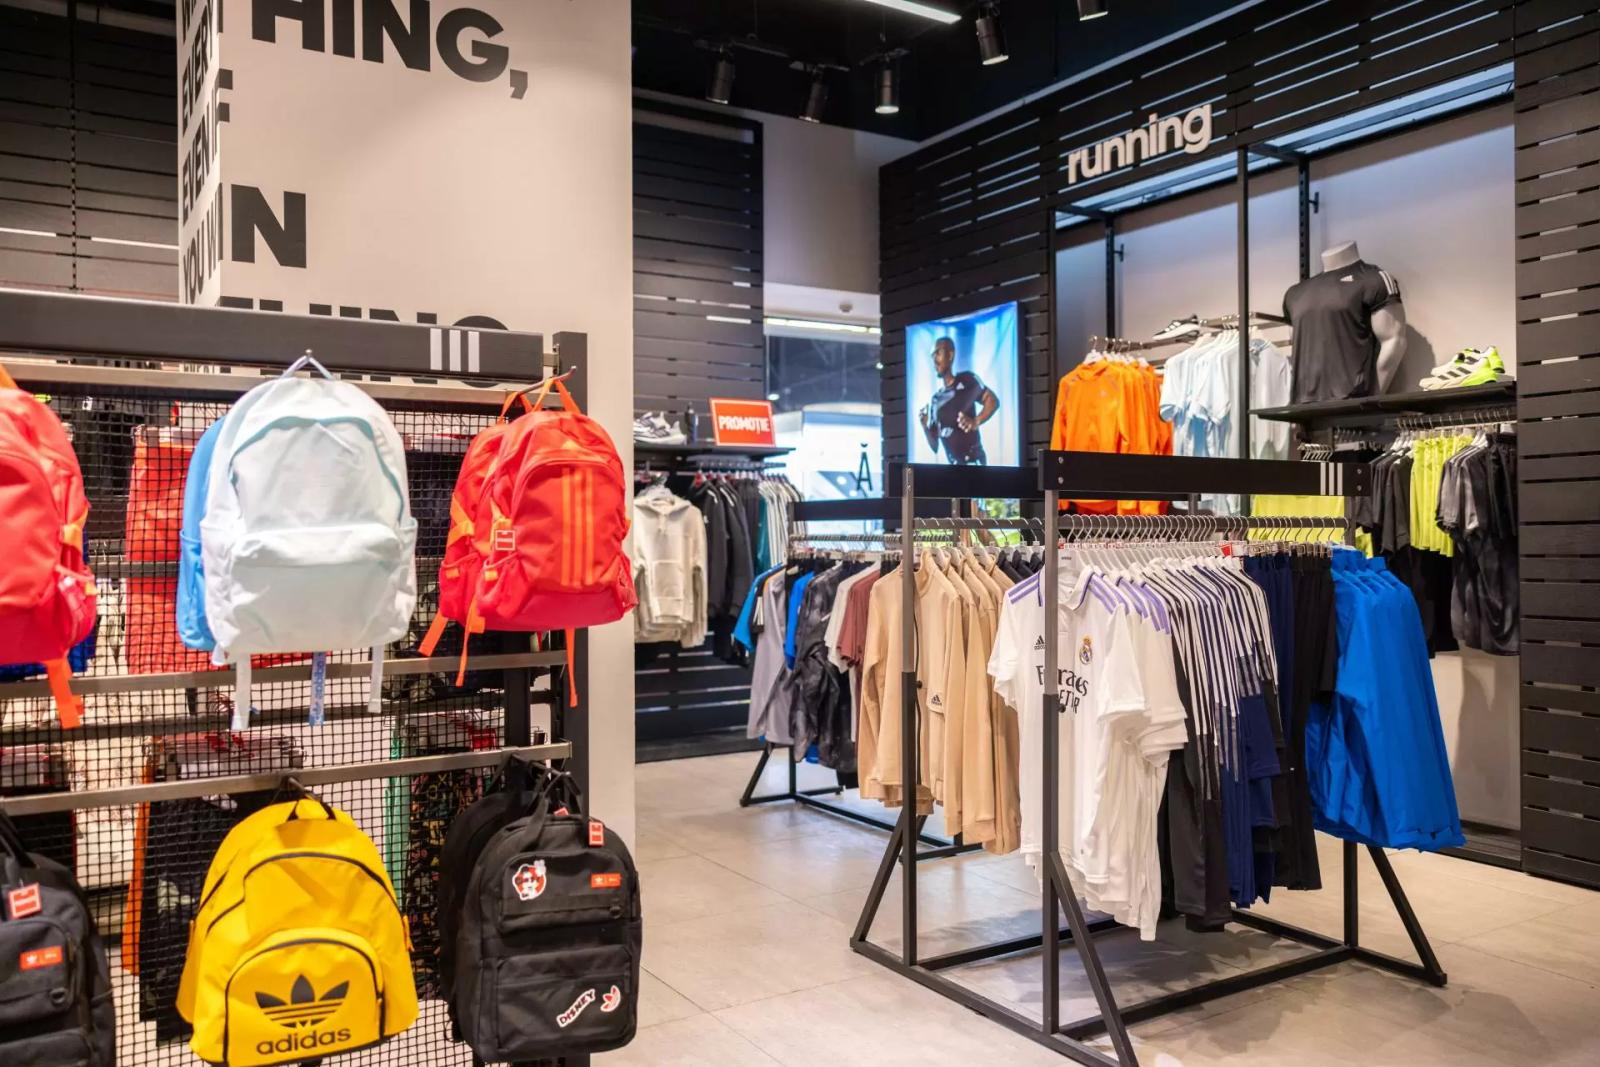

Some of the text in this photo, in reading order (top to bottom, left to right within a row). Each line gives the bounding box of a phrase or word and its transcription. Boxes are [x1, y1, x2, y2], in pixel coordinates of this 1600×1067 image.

[182, 101, 210, 227] EVEN
[1068, 103, 1213, 185] running
[182, 219, 205, 305] YOU
[256, 1028, 351, 1055] adidas
